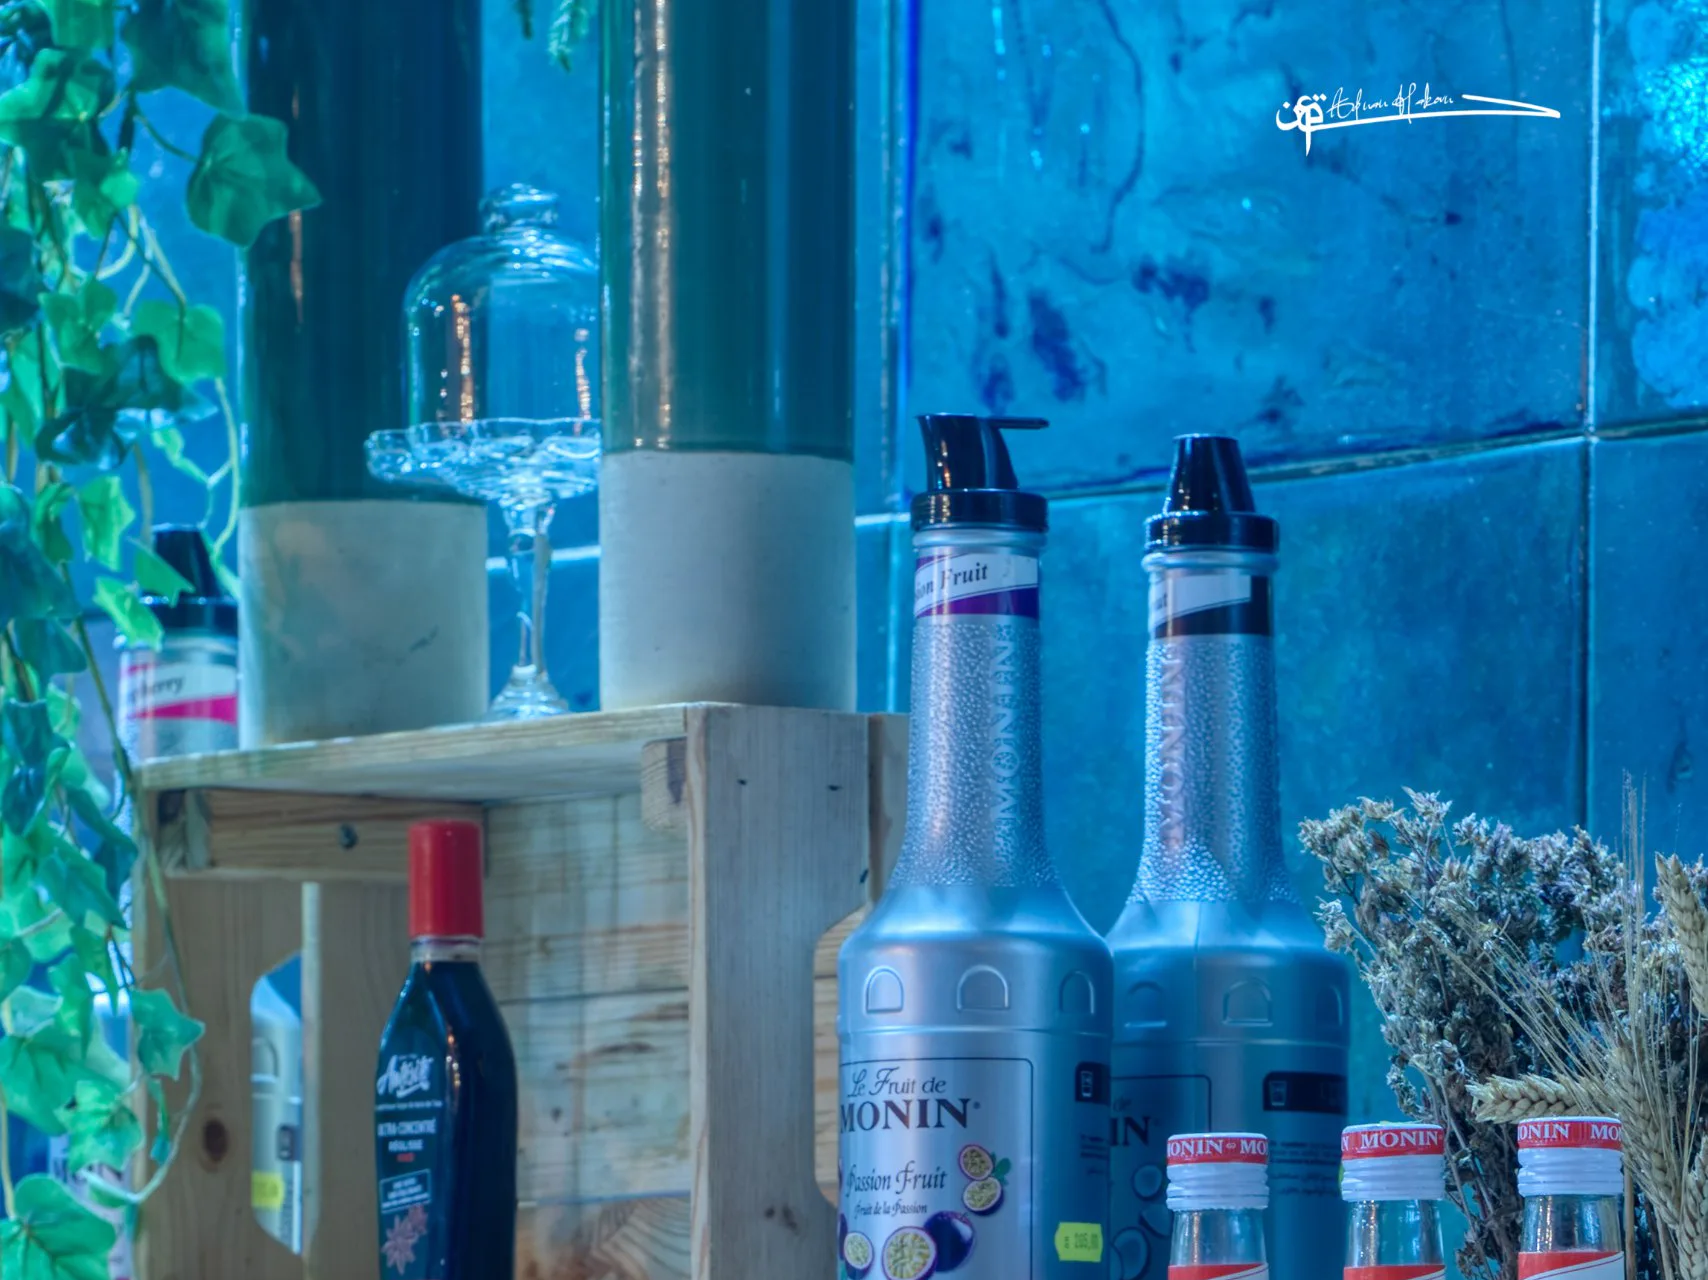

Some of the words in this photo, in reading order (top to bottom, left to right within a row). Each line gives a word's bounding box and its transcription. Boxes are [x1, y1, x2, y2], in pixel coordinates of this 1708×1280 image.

[941, 562, 988, 589] Fruit
[847, 1068, 867, 1098] Le
[869, 1066, 917, 1096] Fruit
[922, 1077, 947, 1094] de
[1361, 1130, 1439, 1150] MONIN
[1517, 1123, 1570, 1141] ONIN
[1591, 1123, 1622, 1141] MO
[1167, 1139, 1224, 1158] ONIN
[1240, 1139, 1268, 1156] MO
[895, 1160, 947, 1195] Fruit
